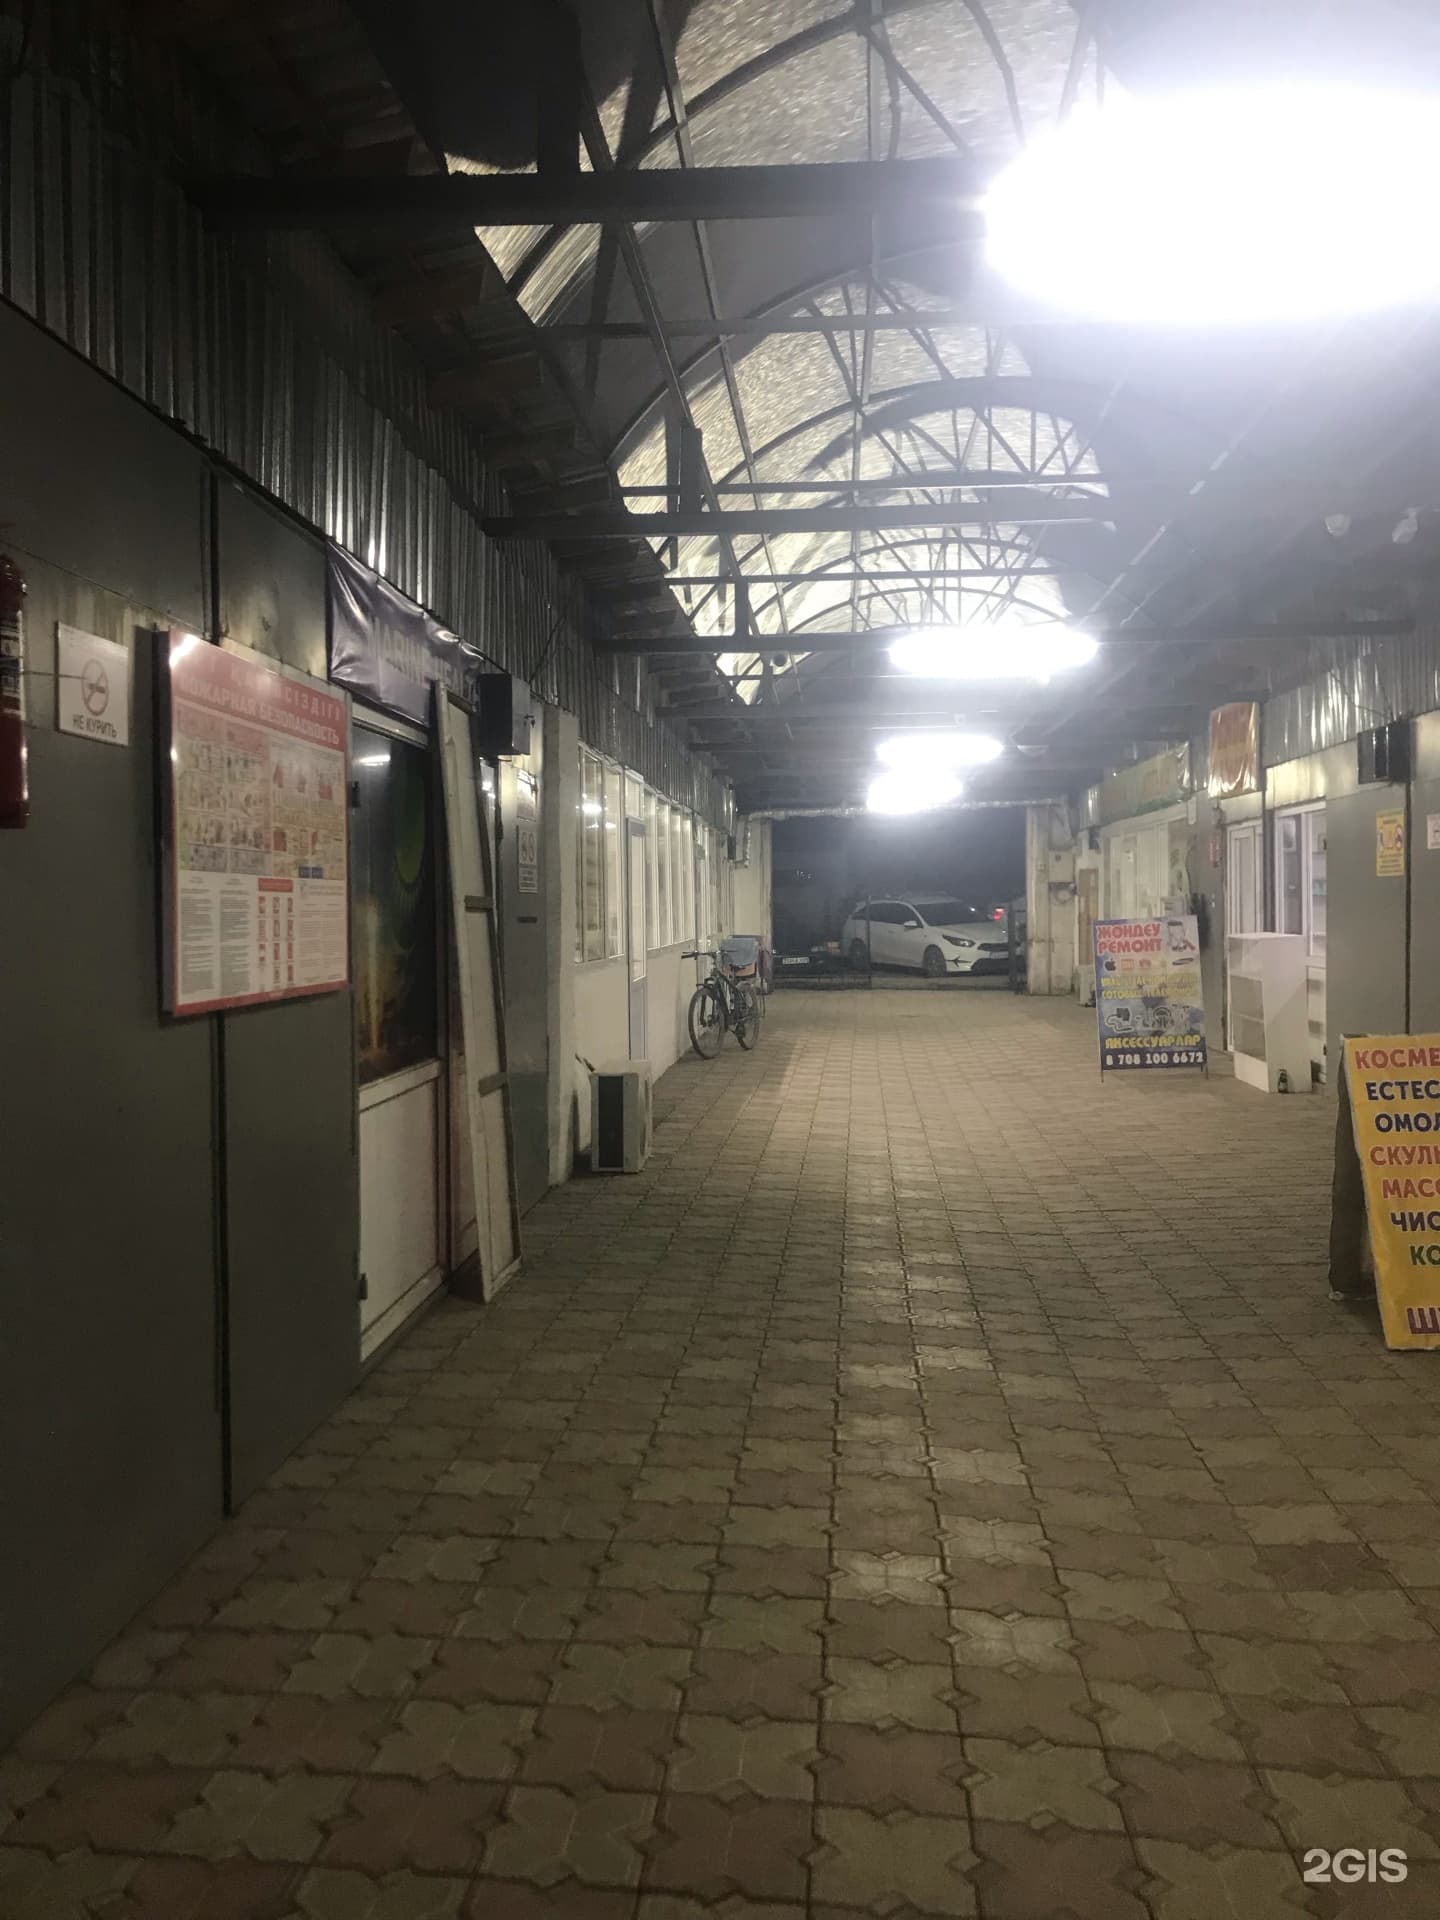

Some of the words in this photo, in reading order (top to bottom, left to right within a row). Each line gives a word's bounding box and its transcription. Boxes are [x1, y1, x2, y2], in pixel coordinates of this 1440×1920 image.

[73, 711, 84, 730] НЕ
[86, 717, 118, 738] КУРИТЬ
[1099, 938, 1162, 954] РЕМОНТ
[1146, 1053, 1168, 1064] 100
[1173, 1052, 1203, 1063] 6672
[1355, 1047, 1440, 1069] КОСМЕ
[1366, 1080, 1440, 1101] ЕСТЕС
[1390, 1210, 1440, 1232] ЧИС
[1406, 1307, 1440, 1334] Ш
